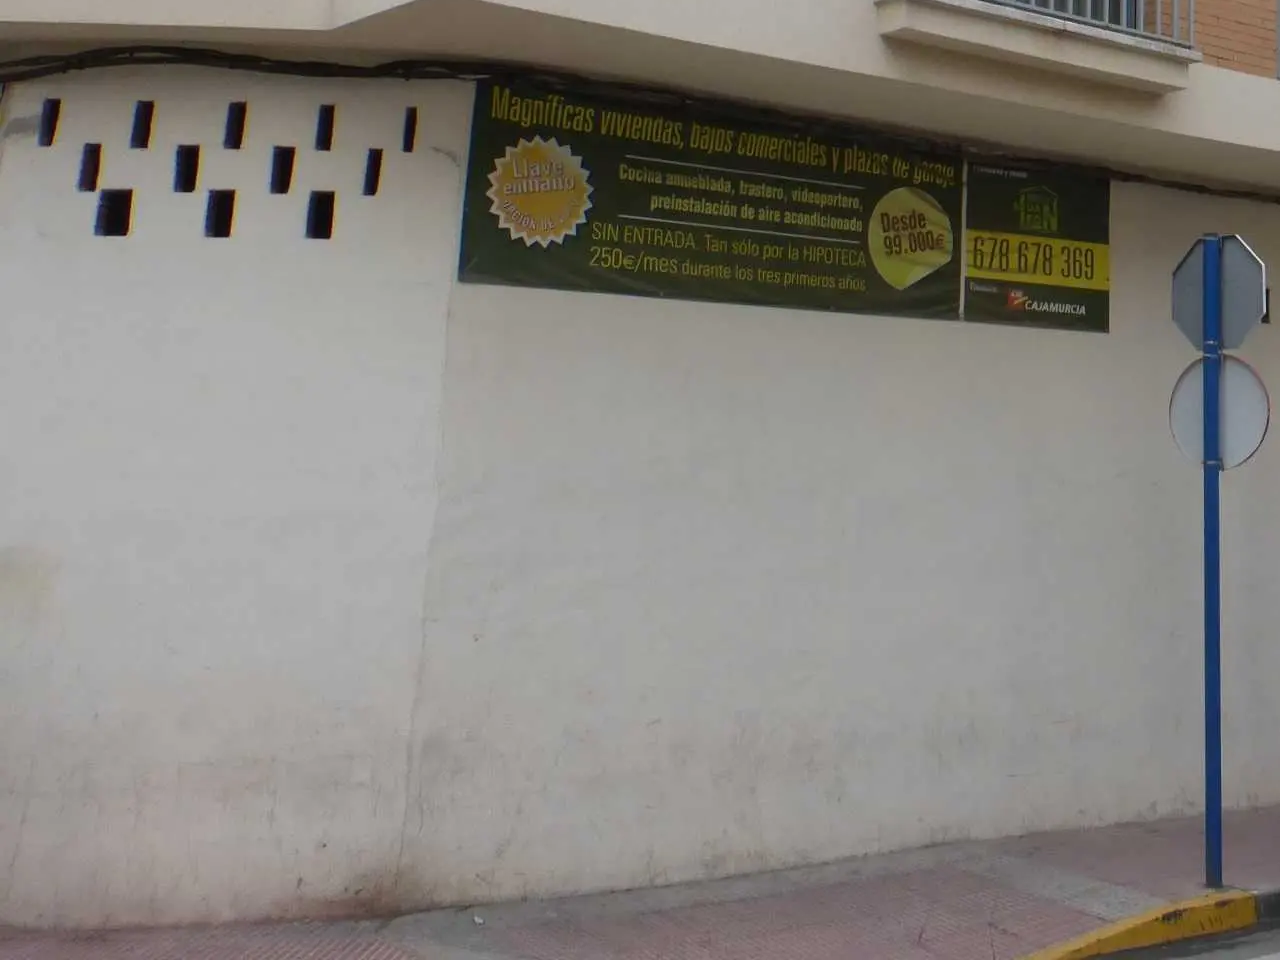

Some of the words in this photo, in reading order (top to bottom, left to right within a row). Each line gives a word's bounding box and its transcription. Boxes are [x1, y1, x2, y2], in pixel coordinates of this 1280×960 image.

[491, 85, 595, 133] Magníficas
[600, 109, 686, 149] viviendas,
[690, 120, 735, 155] bajos
[737, 132, 828, 167] comerciales
[831, 147, 841, 173] y
[843, 145, 890, 176] plazas
[892, 152, 911, 179] de
[512, 159, 565, 178] Llave
[618, 163, 662, 184] Cocina
[665, 171, 736, 196] amueblada,
[650, 194, 738, 218] preinstalación
[740, 204, 757, 221] de
[758, 206, 782, 224] aire
[783, 210, 864, 233] acondicionado
[880, 209, 928, 233] Desde
[591, 222, 621, 242] SIN
[704, 233, 729, 253] Tan
[731, 238, 761, 258] sólo
[763, 243, 786, 261] por
[788, 245, 802, 260] la
[803, 247, 867, 268] HIPOTECA
[883, 229, 946, 256] 99.000€
[972, 236, 1011, 274] 678
[1018, 241, 1053, 276] 678
[1061, 246, 1096, 282] 369
[589, 246, 680, 276] 250€/mes
[681, 263, 732, 280] durante
[735, 264, 755, 282] los
[757, 268, 781, 284] tres
[783, 273, 837, 291] primeros
[838, 274, 867, 292] años
[1024, 300, 1087, 316] CAJAMURCIA
